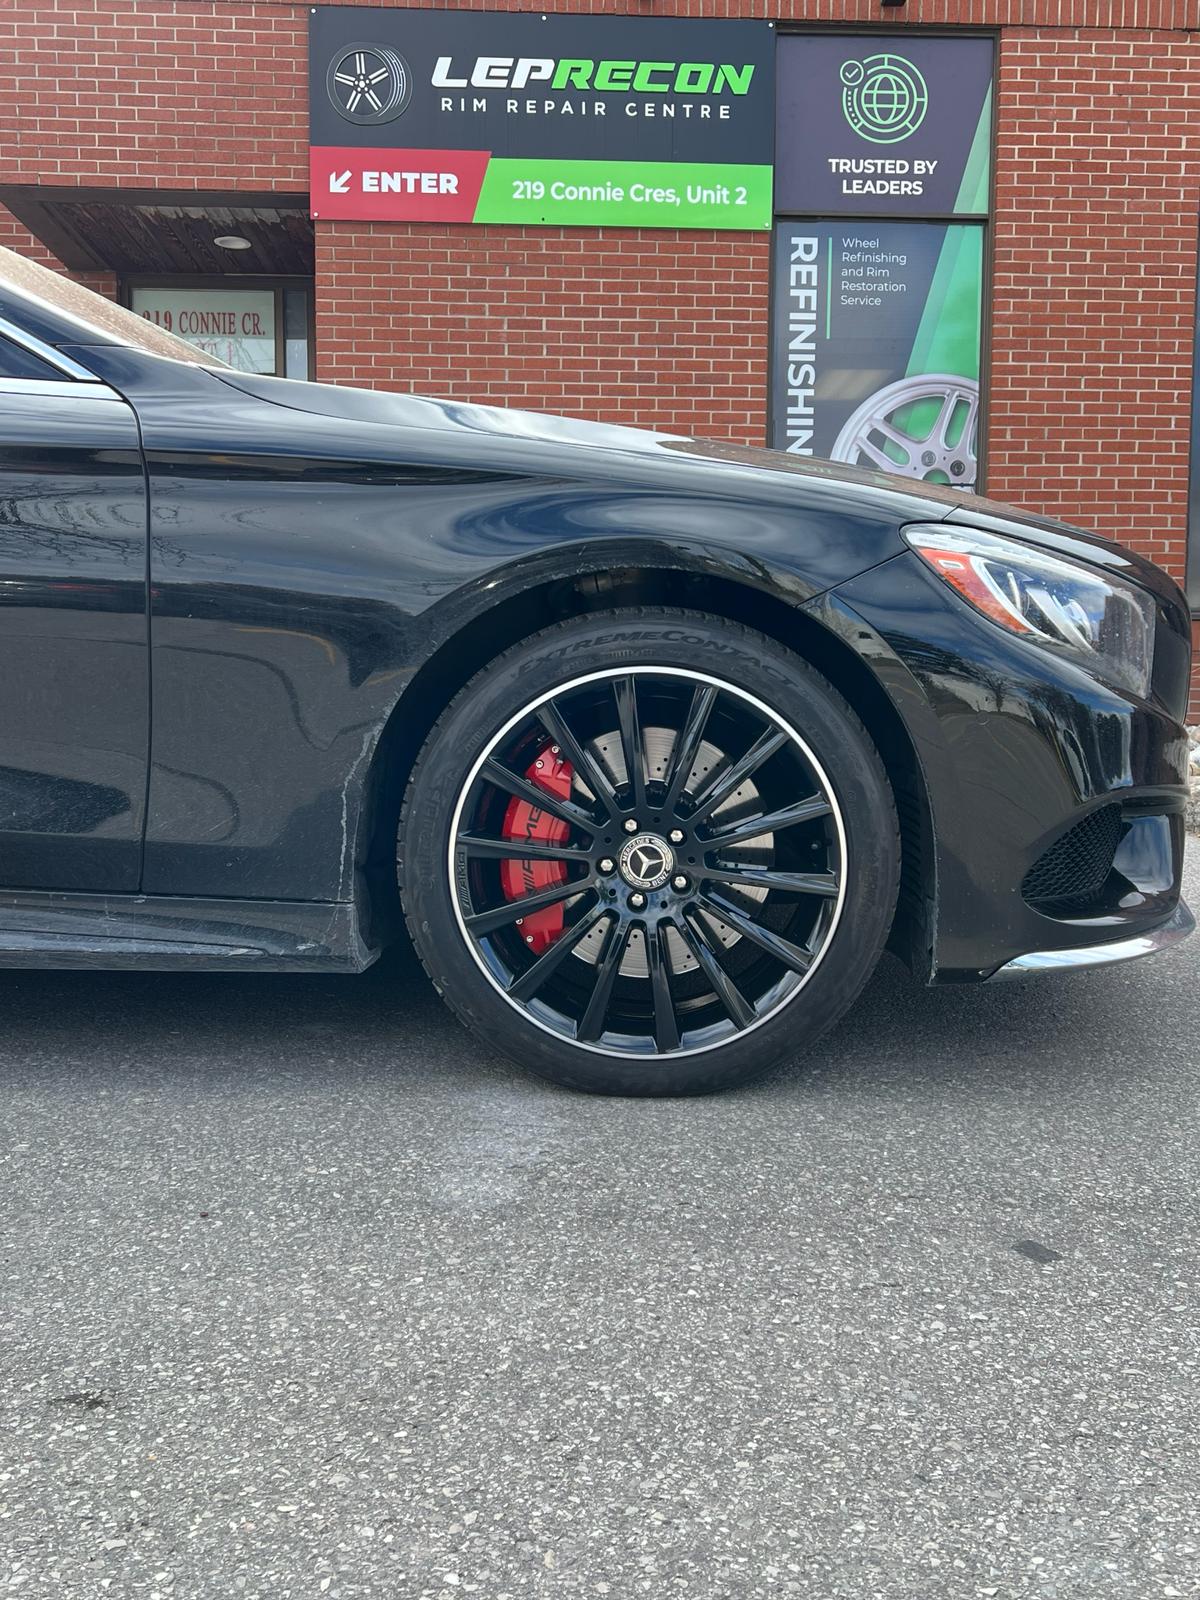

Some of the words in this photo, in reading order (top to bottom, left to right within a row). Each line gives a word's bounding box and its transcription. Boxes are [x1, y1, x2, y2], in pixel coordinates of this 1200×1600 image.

[431, 56, 755, 95] LEPRECON
[441, 97, 487, 113] RIM
[506, 99, 606, 116] REPAIR
[625, 102, 730, 119] CENTRE
[827, 158, 909, 175] TRUSTED
[913, 159, 938, 175] BY
[362, 171, 459, 194] ENTER
[841, 179, 924, 196] LEADERS
[511, 180, 545, 201] 219
[549, 181, 625, 202] Connie
[628, 184, 681, 207] Cres,
[686, 184, 731, 205] Unit
[734, 187, 748, 206] 2
[842, 237, 880, 249] Wheel
[841, 251, 907, 266] Refinishing
[841, 265, 864, 278] and
[866, 266, 890, 278] Rim
[841, 280, 907, 293] Restoration
[840, 294, 882, 307] Service
[178, 311, 237, 335] CONNIE
[241, 311, 267, 336] CR.
[622, 837, 650, 861] MERCEDES
[651, 870, 670, 887] BENZ
